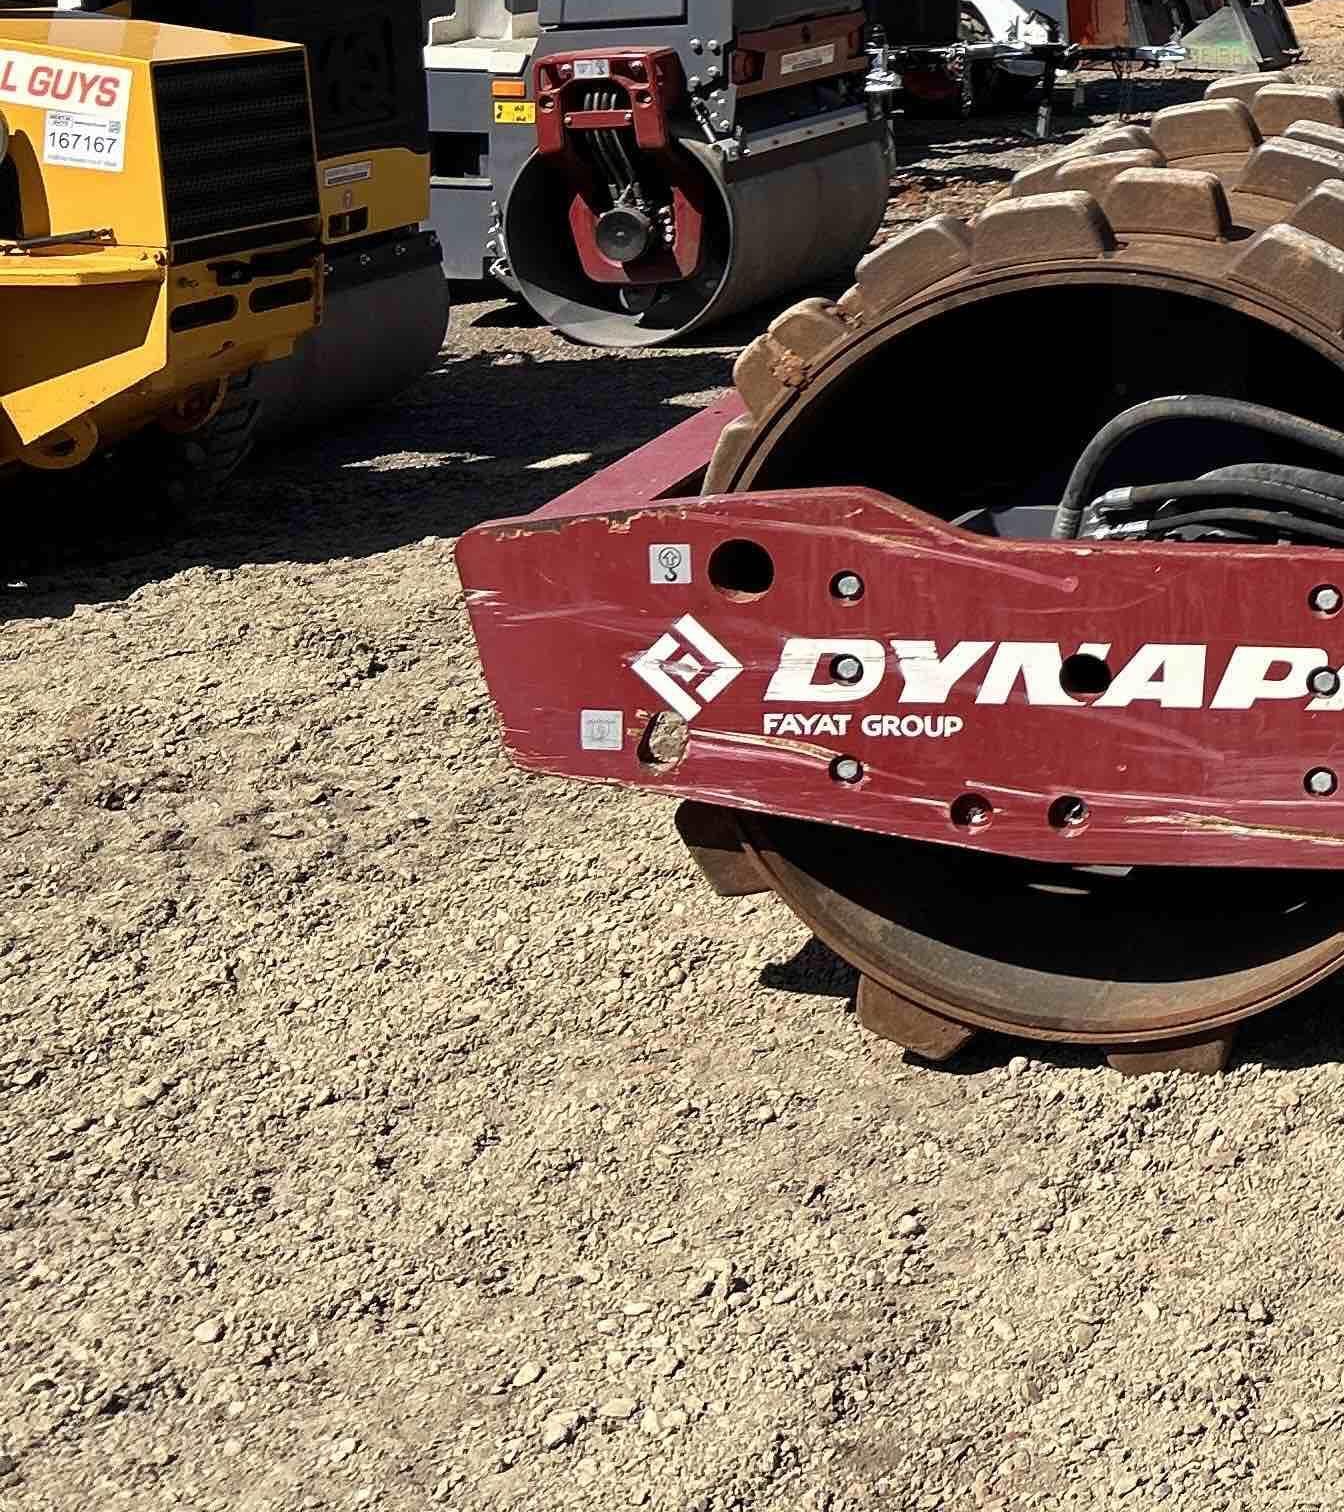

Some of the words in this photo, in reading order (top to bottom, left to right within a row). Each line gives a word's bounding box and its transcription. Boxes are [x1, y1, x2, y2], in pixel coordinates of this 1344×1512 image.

[27, 65, 120, 107] GUYS
[49, 131, 118, 154] 167167
[763, 713, 852, 737] FAYAT
[860, 713, 964, 738] GROUP
